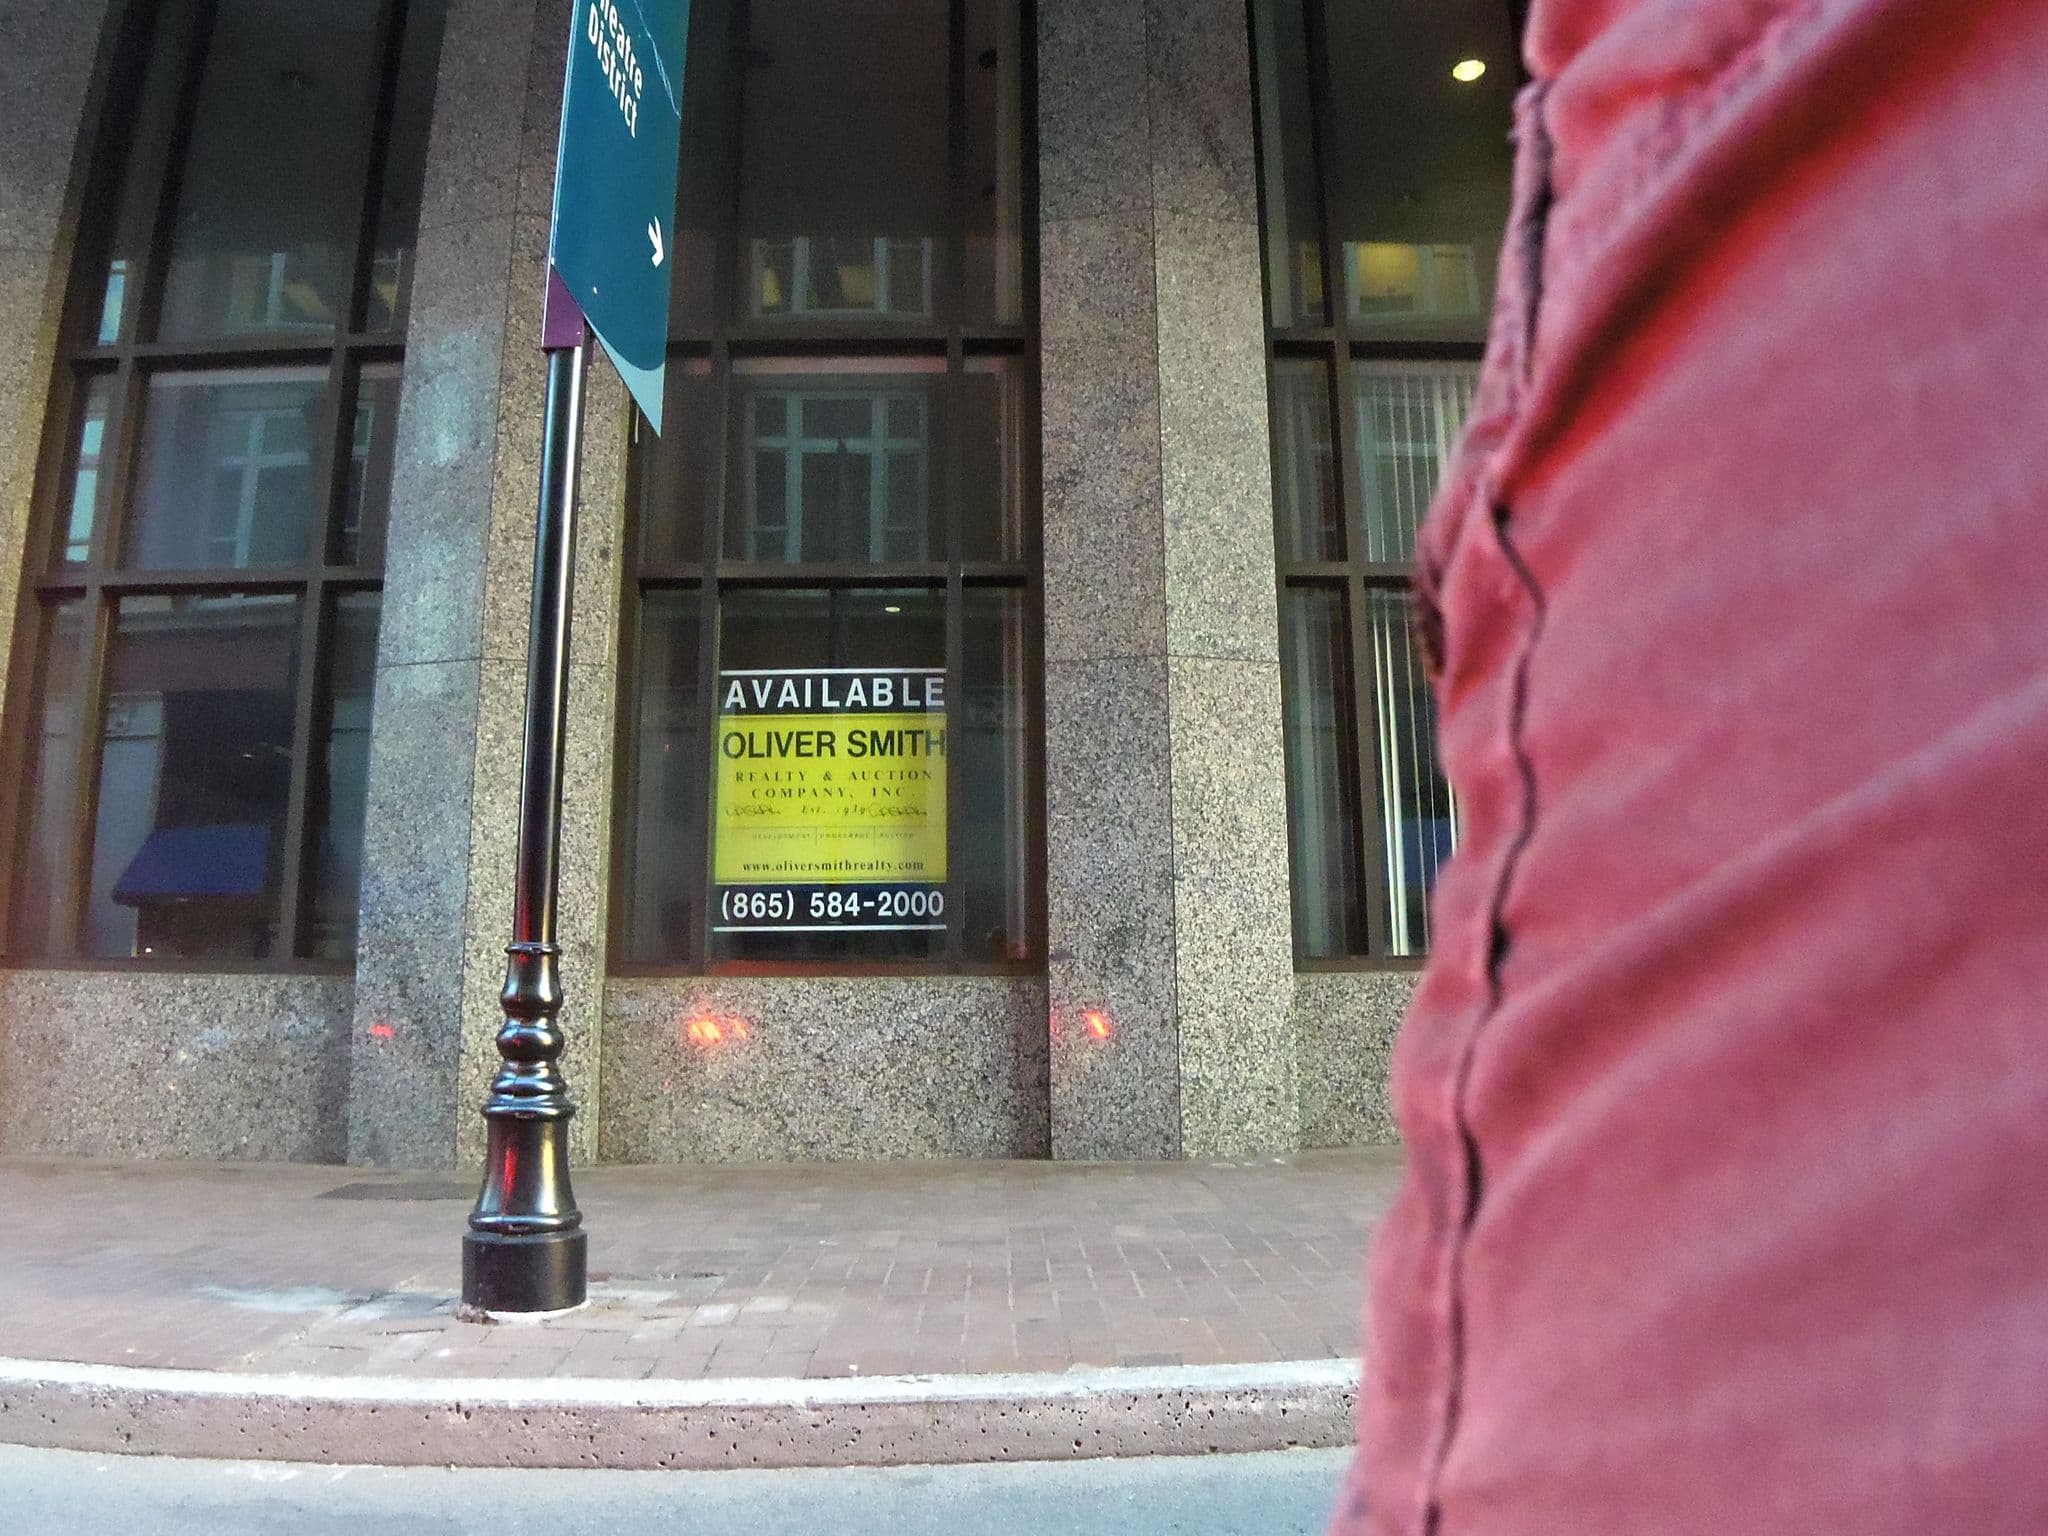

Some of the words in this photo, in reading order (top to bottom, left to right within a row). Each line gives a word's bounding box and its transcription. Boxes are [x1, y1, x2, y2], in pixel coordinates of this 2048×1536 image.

[600, 0, 642, 99] eatre
[588, 2, 637, 138] District
[724, 677, 945, 709] AVAILABLE
[723, 730, 836, 759] OLIVER
[846, 729, 945, 758] SMITH
[735, 771, 807, 783] REALTY
[822, 771, 833, 782] &
[849, 770, 932, 782] AUCTION
[751, 787, 855, 799] COMPANY,
[742, 859, 924, 873] www.oliversmithrealty.com
[722, 890, 794, 920] (865)
[810, 890, 944, 918] 584-2000
